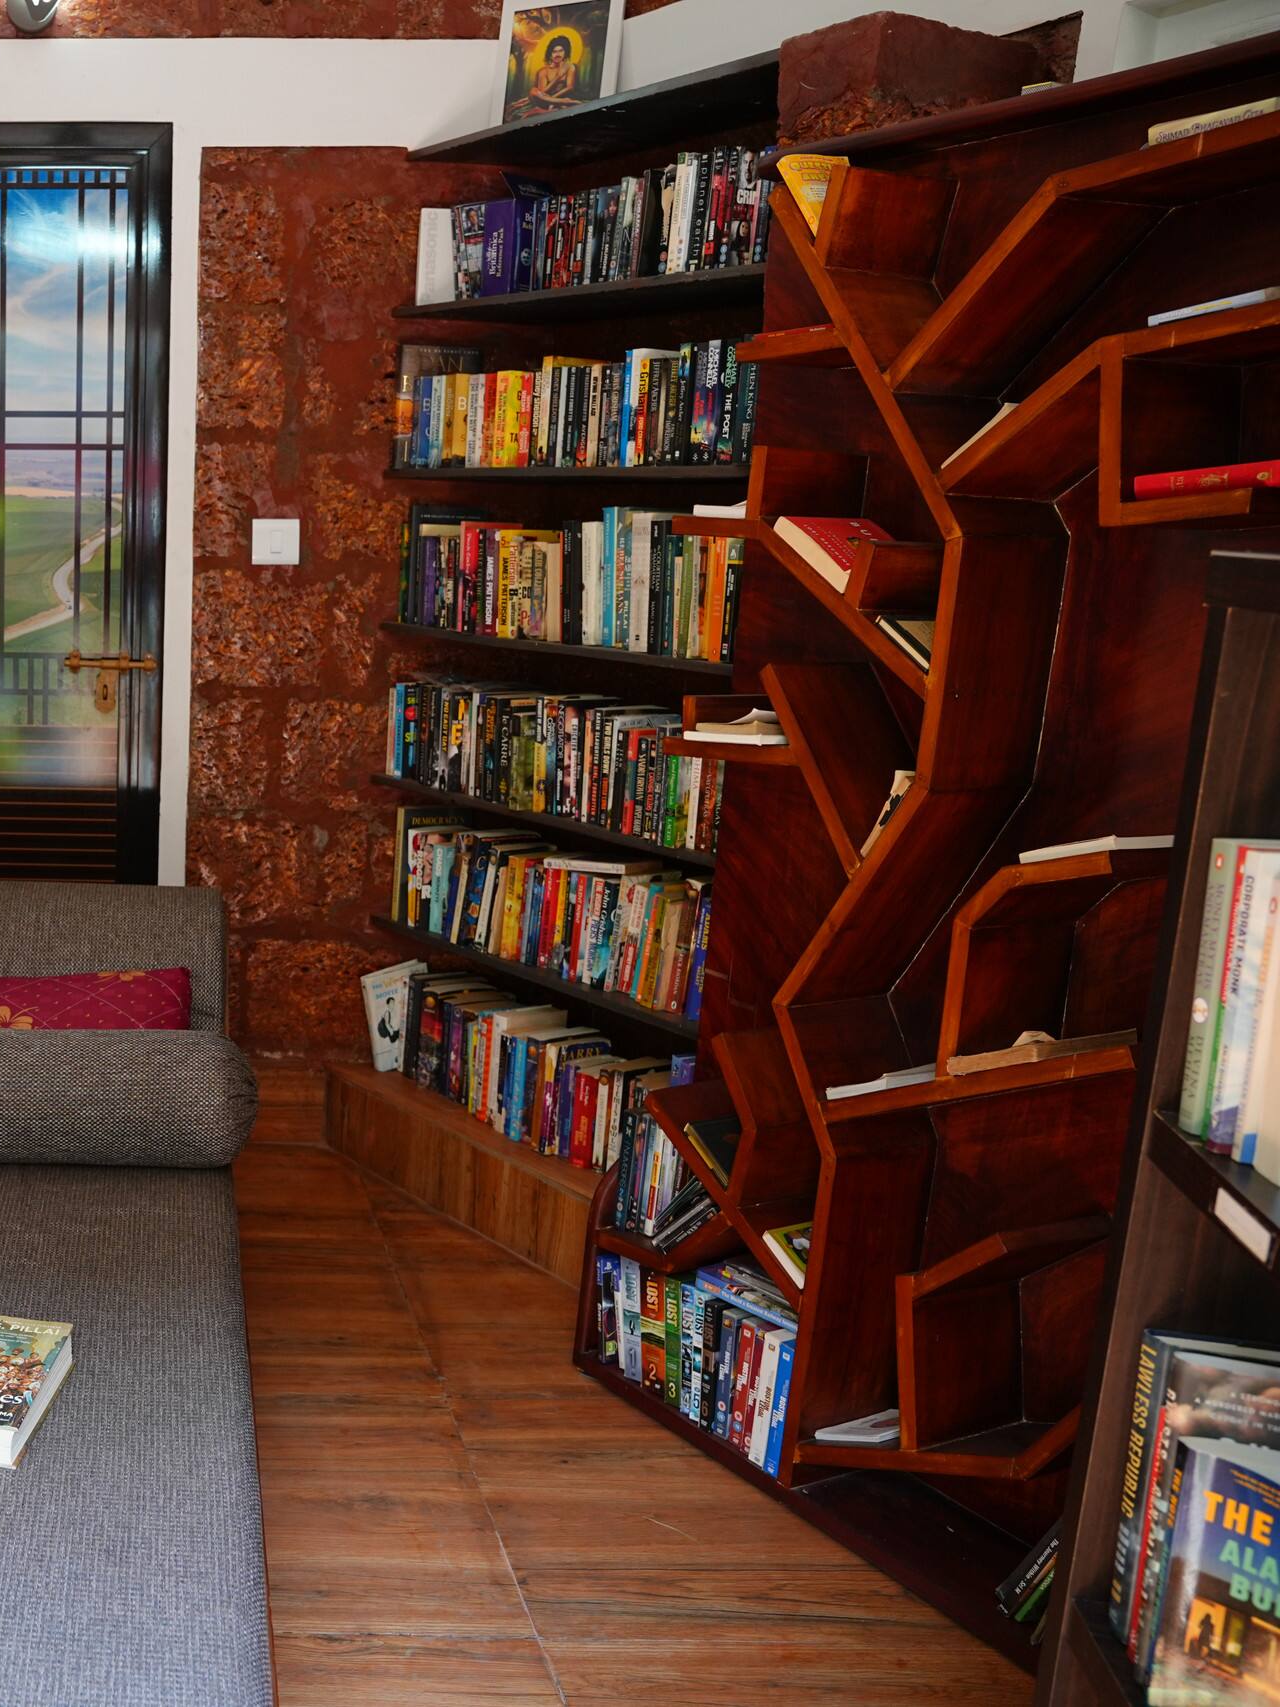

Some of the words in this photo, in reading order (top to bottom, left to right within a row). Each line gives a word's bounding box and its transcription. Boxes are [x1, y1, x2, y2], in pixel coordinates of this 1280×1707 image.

[1156, 128, 1190, 143] SRIMAD
[697, 167, 708, 211] planet
[693, 219, 702, 256] earth
[705, 347, 716, 388] CONNELLY
[710, 349, 720, 385] MICHAEL
[723, 346, 735, 388] CONNELLY
[611, 391, 620, 419] GRISHAM
[637, 371, 648, 415] Grisham
[724, 392, 733, 410] THE
[745, 392, 755, 419] KING
[532, 397, 540, 428] sheldon
[721, 414, 730, 439] POET
[486, 556, 494, 580] JAMES
[509, 545, 518, 585] Patterson
[484, 582, 493, 624] PATTERSON
[501, 715, 509, 724] le
[556, 704, 565, 758] NEGOTIATOR
[595, 711, 603, 731] KARIN
[604, 721, 612, 735] TWO
[593, 731, 601, 764] SLAUGHTER
[603, 736, 611, 754] GIRLS
[602, 755, 610, 773] DOWN
[597, 909, 608, 944] Grisham
[1237, 876, 1254, 949] CORPORATE
[700, 913, 712, 950] ADAMS
[1231, 955, 1245, 996] MONK
[625, 1272, 637, 1304] LOST
[646, 1281, 659, 1313] LOST
[666, 1298, 678, 1328] LOST
[682, 1306, 694, 1334] LOST
[694, 1310, 704, 1336] LOST
[9, 1324, 60, 1336] PILLAI
[703, 1323, 714, 1347] LOST
[648, 1363, 657, 1380] 2
[1133, 1343, 1157, 1428] LAWLESS
[668, 1382, 676, 1398] 3
[682, 1393, 690, 1408] 4
[692, 1393, 700, 1409] 5
[701, 1401, 709, 1416] 6
[1121, 1430, 1144, 1518] REPUBLIC
[1203, 1489, 1275, 1547] THE
